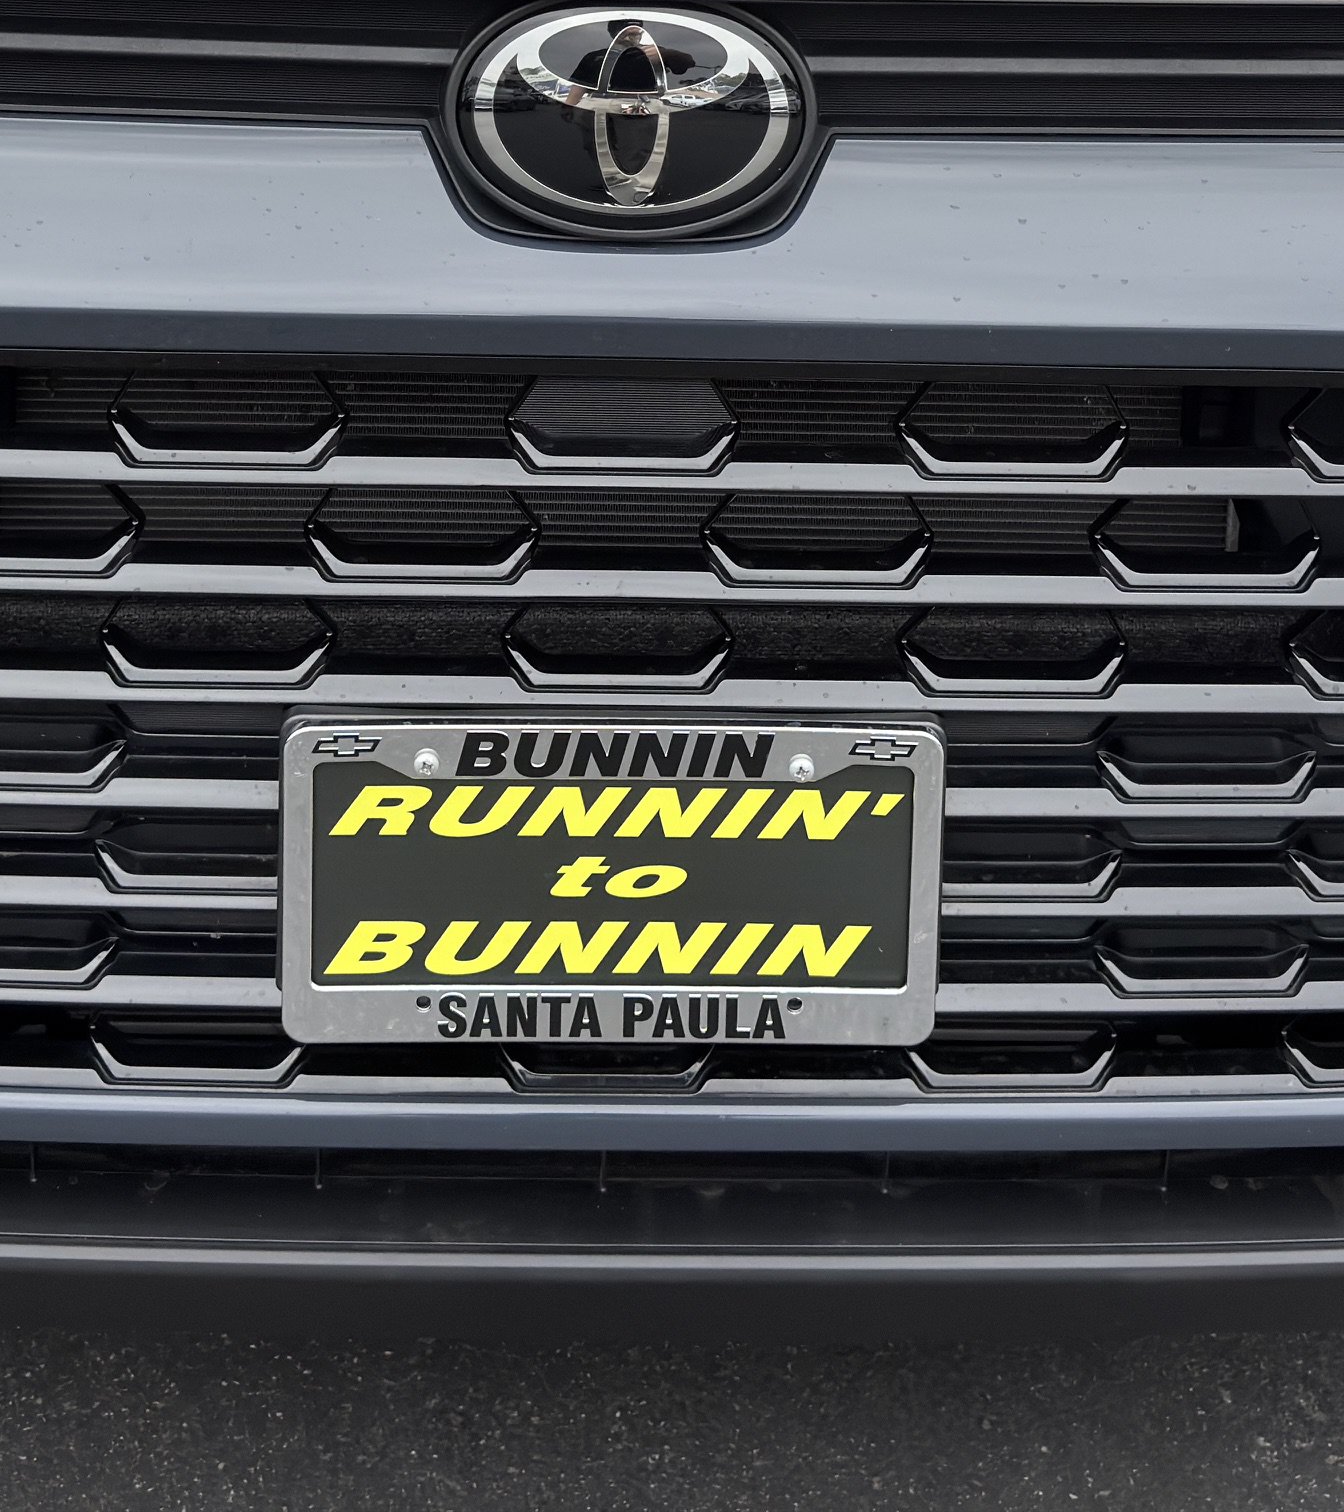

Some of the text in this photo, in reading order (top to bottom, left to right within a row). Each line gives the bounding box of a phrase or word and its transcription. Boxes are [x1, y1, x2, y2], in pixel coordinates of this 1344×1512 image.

[454, 730, 775, 778] BUNNIN
[329, 785, 906, 841] RUNNIN'
[549, 856, 689, 899] to
[323, 920, 873, 978] BUNNIN
[437, 991, 786, 1039] SANTA PAULA
